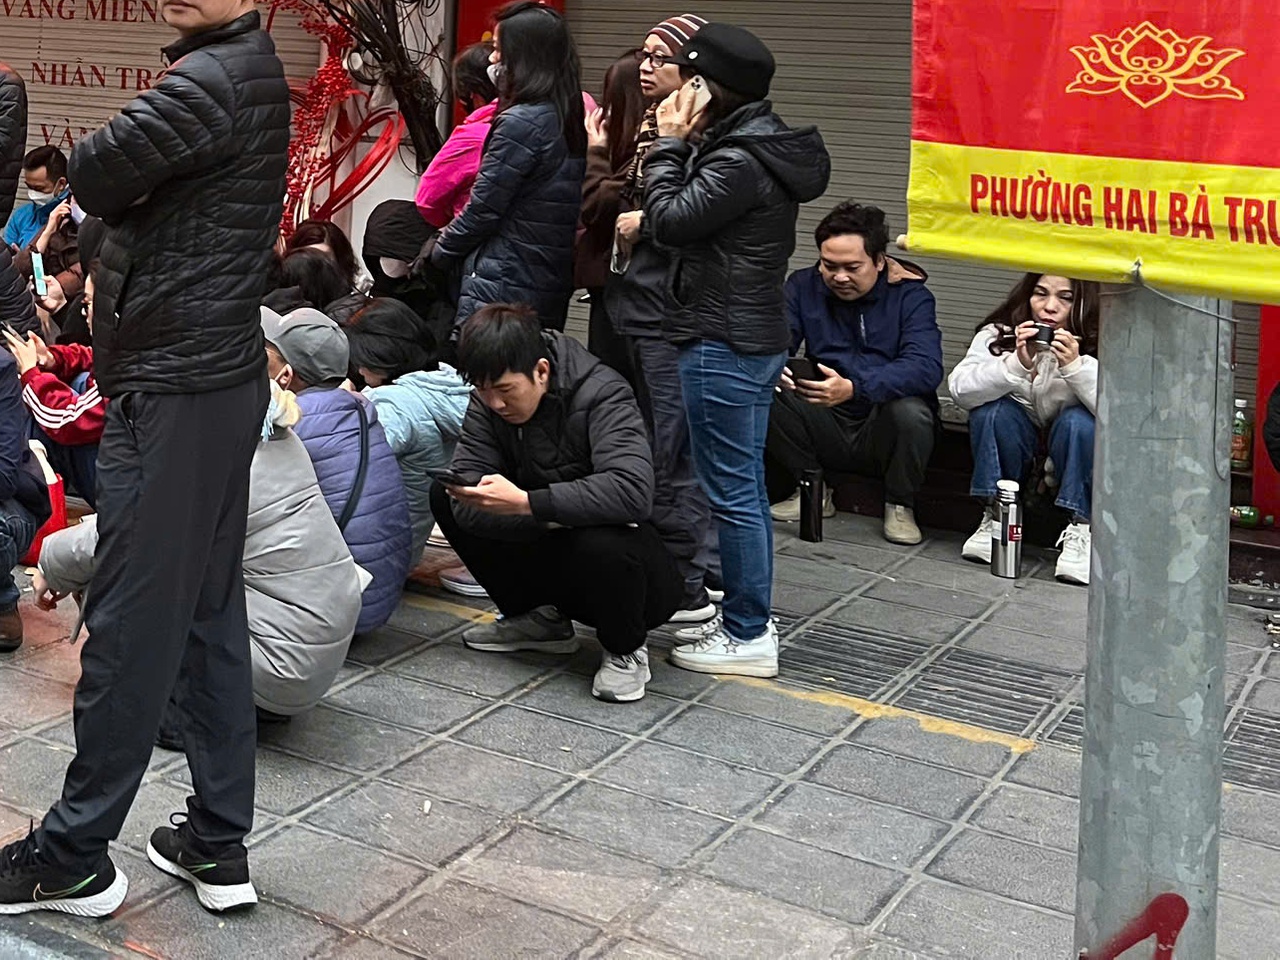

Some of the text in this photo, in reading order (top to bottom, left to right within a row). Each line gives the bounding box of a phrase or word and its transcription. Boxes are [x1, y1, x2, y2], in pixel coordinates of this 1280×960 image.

[31, 57, 107, 88] NHẪN
[970, 169, 1094, 227] PHƯỜNG
[1103, 186, 1158, 234] HAI
[1170, 184, 1215, 240] BÀ
